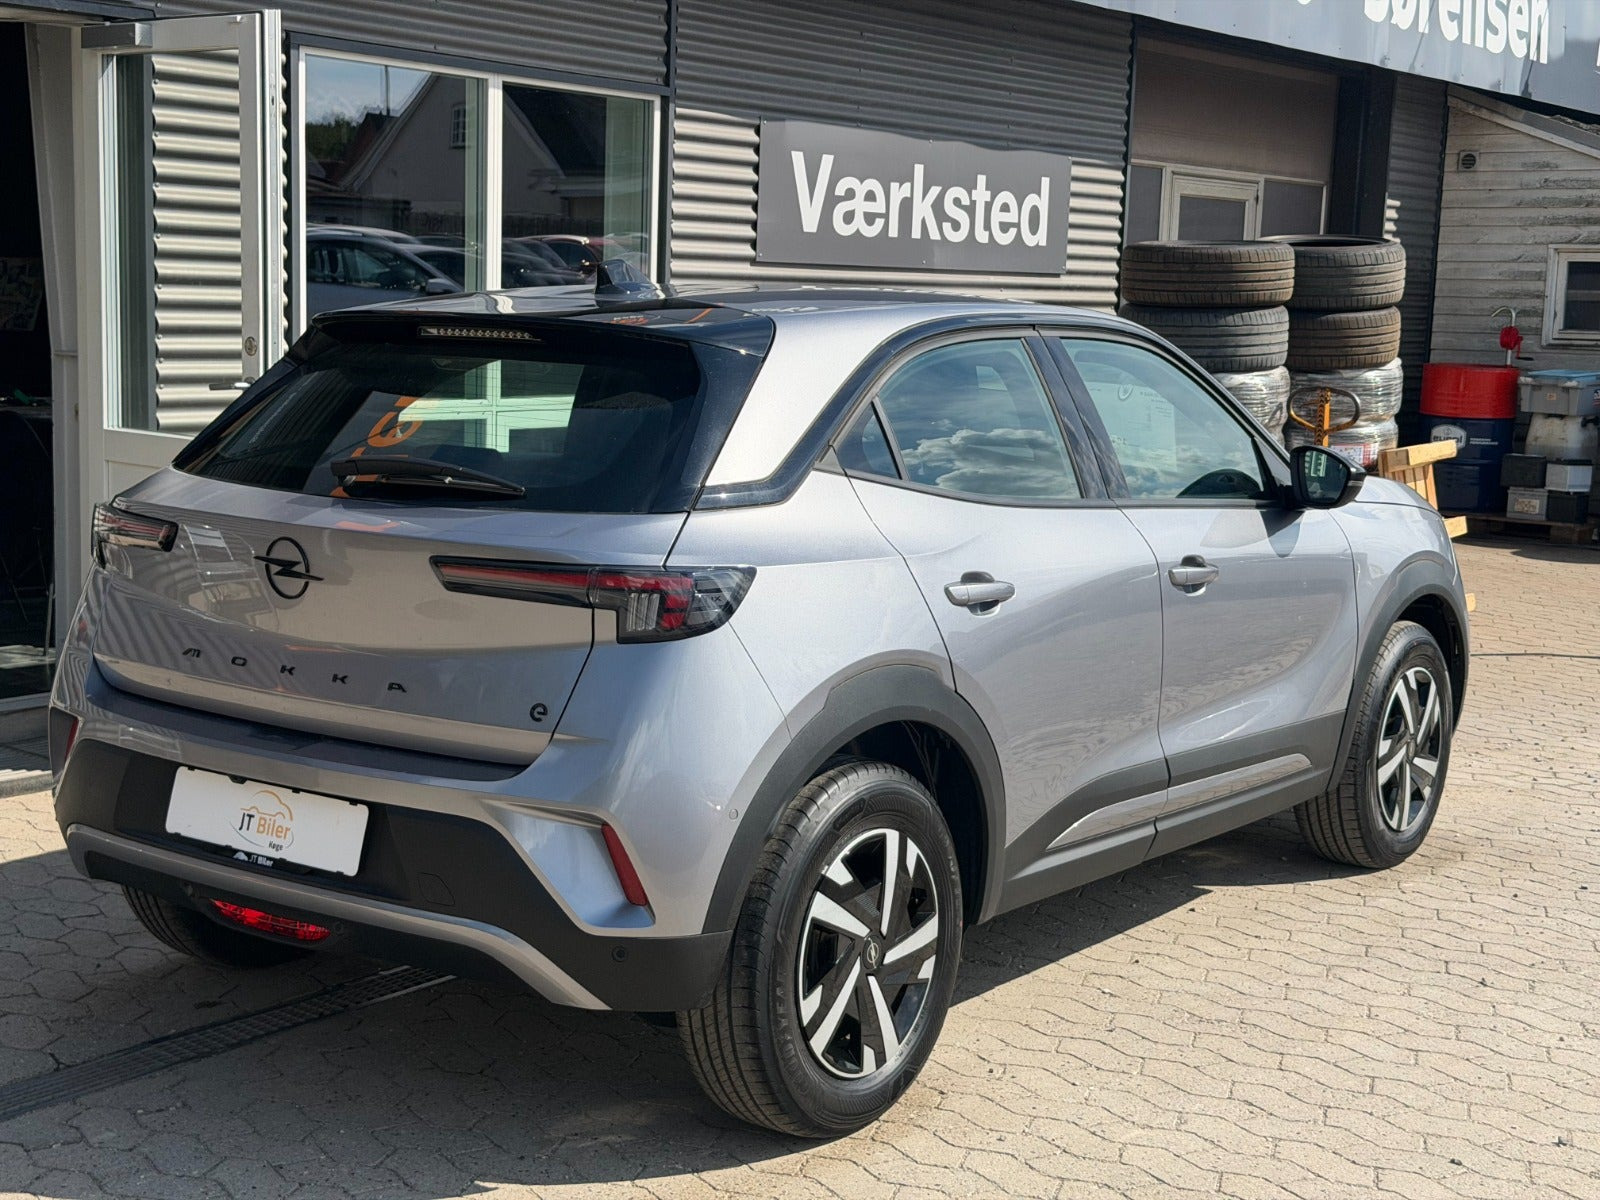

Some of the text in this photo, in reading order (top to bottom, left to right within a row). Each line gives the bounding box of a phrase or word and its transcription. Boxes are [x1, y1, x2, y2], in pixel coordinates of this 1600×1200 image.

[791, 150, 1050, 247] Værksted
[182, 647, 407, 693] MOKKA
[239, 812, 291, 840] JT Biler
[257, 856, 274, 867] Biler
